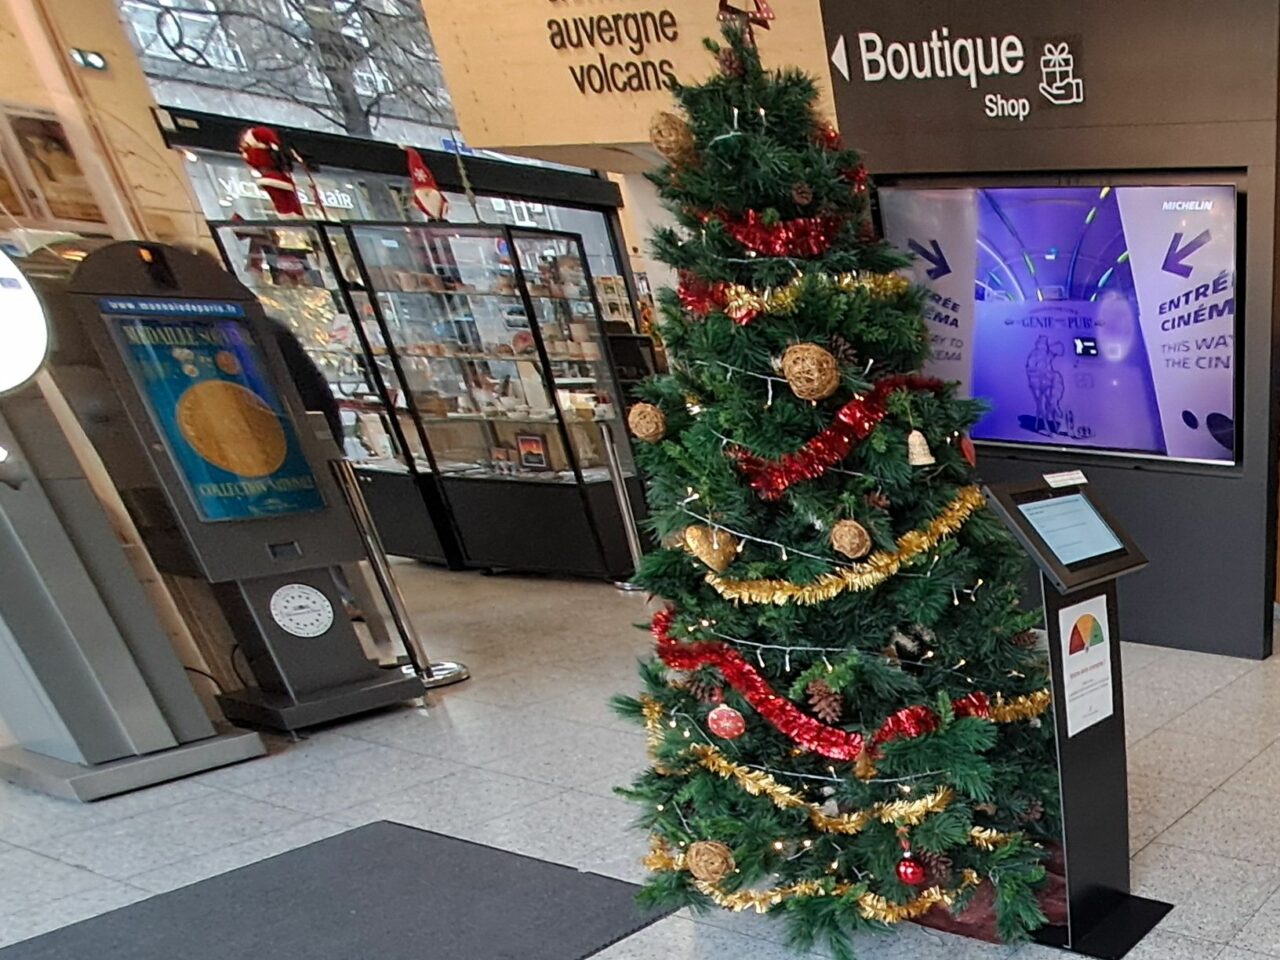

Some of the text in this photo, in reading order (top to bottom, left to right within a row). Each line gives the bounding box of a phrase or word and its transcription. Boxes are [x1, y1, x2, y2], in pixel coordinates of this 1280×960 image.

[547, 9, 678, 55] auvergne
[858, 27, 1025, 88] Boutique
[569, 52, 677, 94] volcans
[985, 94, 1030, 121] Shop
[1162, 201, 1213, 211] MICHELIN
[1161, 341, 1190, 353] THIS
[1165, 357, 1191, 369] THE
